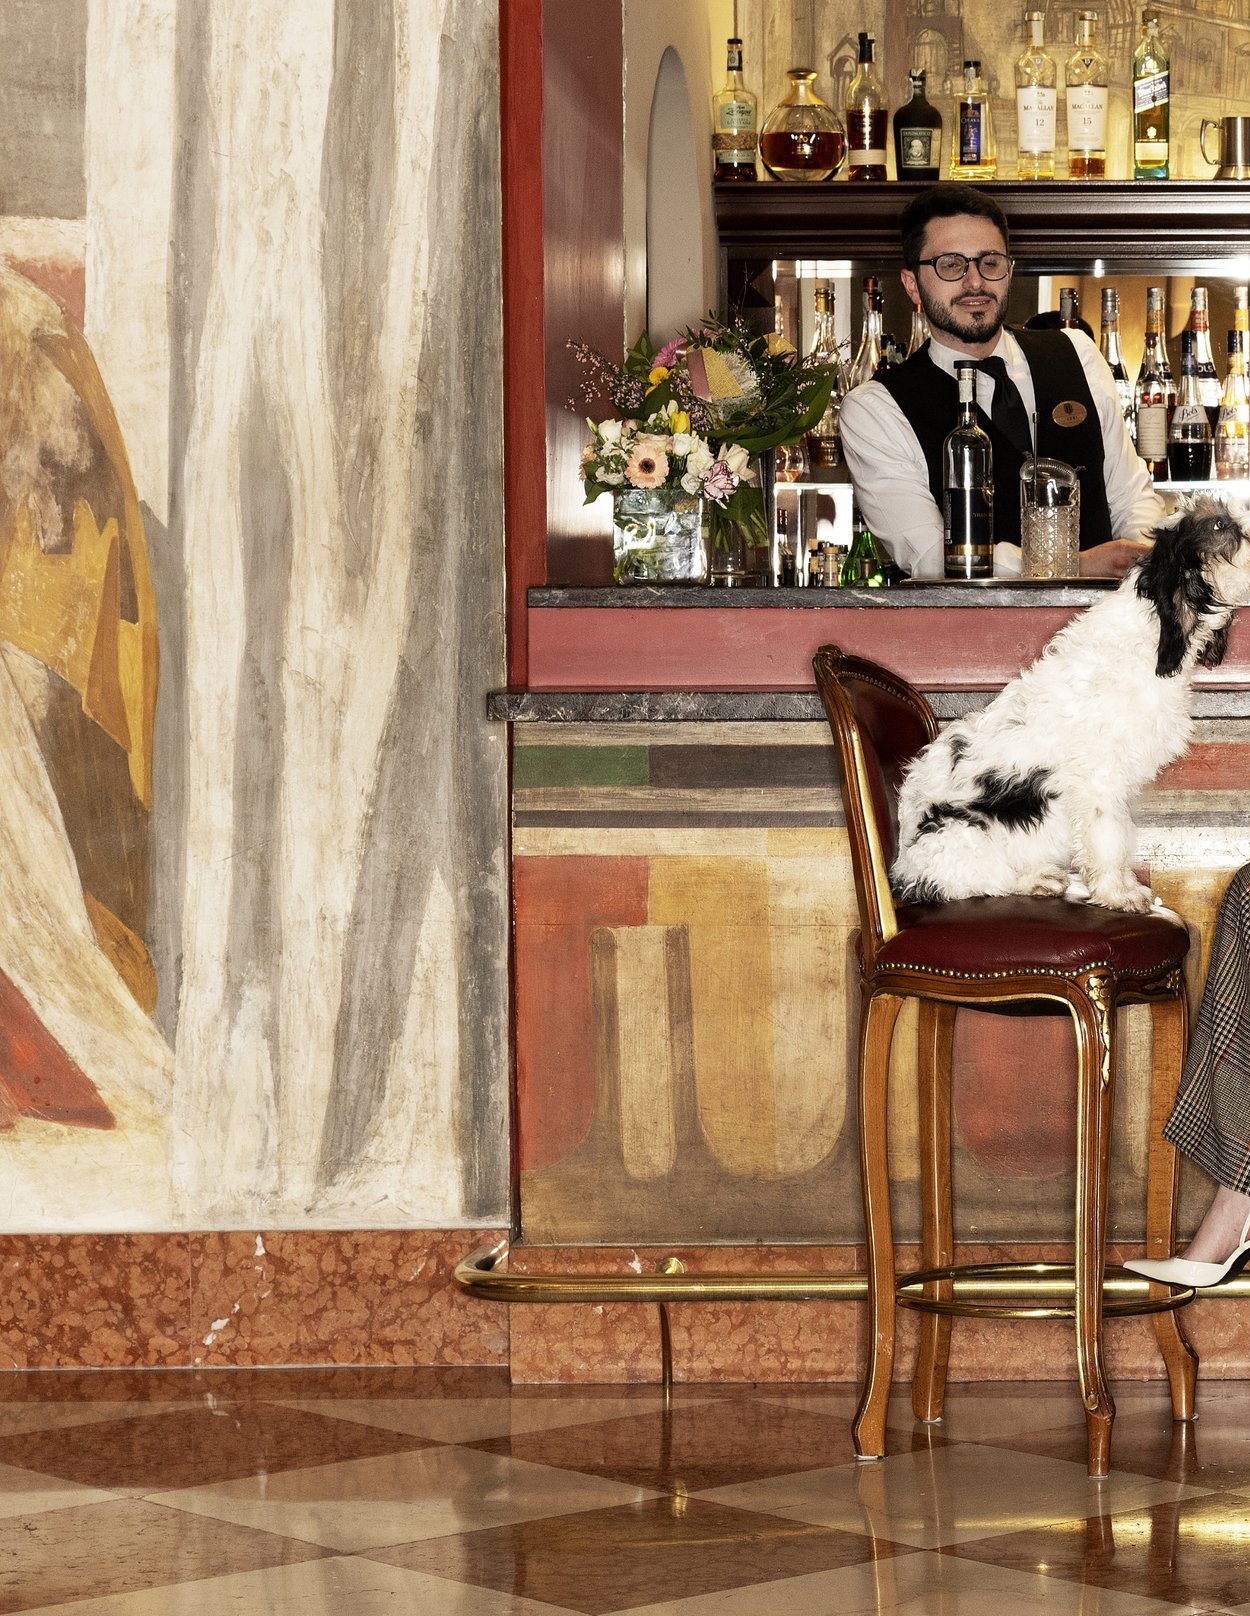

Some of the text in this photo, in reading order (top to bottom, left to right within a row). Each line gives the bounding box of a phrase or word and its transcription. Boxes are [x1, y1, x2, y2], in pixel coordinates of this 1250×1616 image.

[1036, 118, 1045, 127] 12
[1083, 117, 1092, 126] 15
[1198, 364, 1213, 373] OLS
[1179, 406, 1198, 418] Bols
[1222, 407, 1238, 419] Bols
